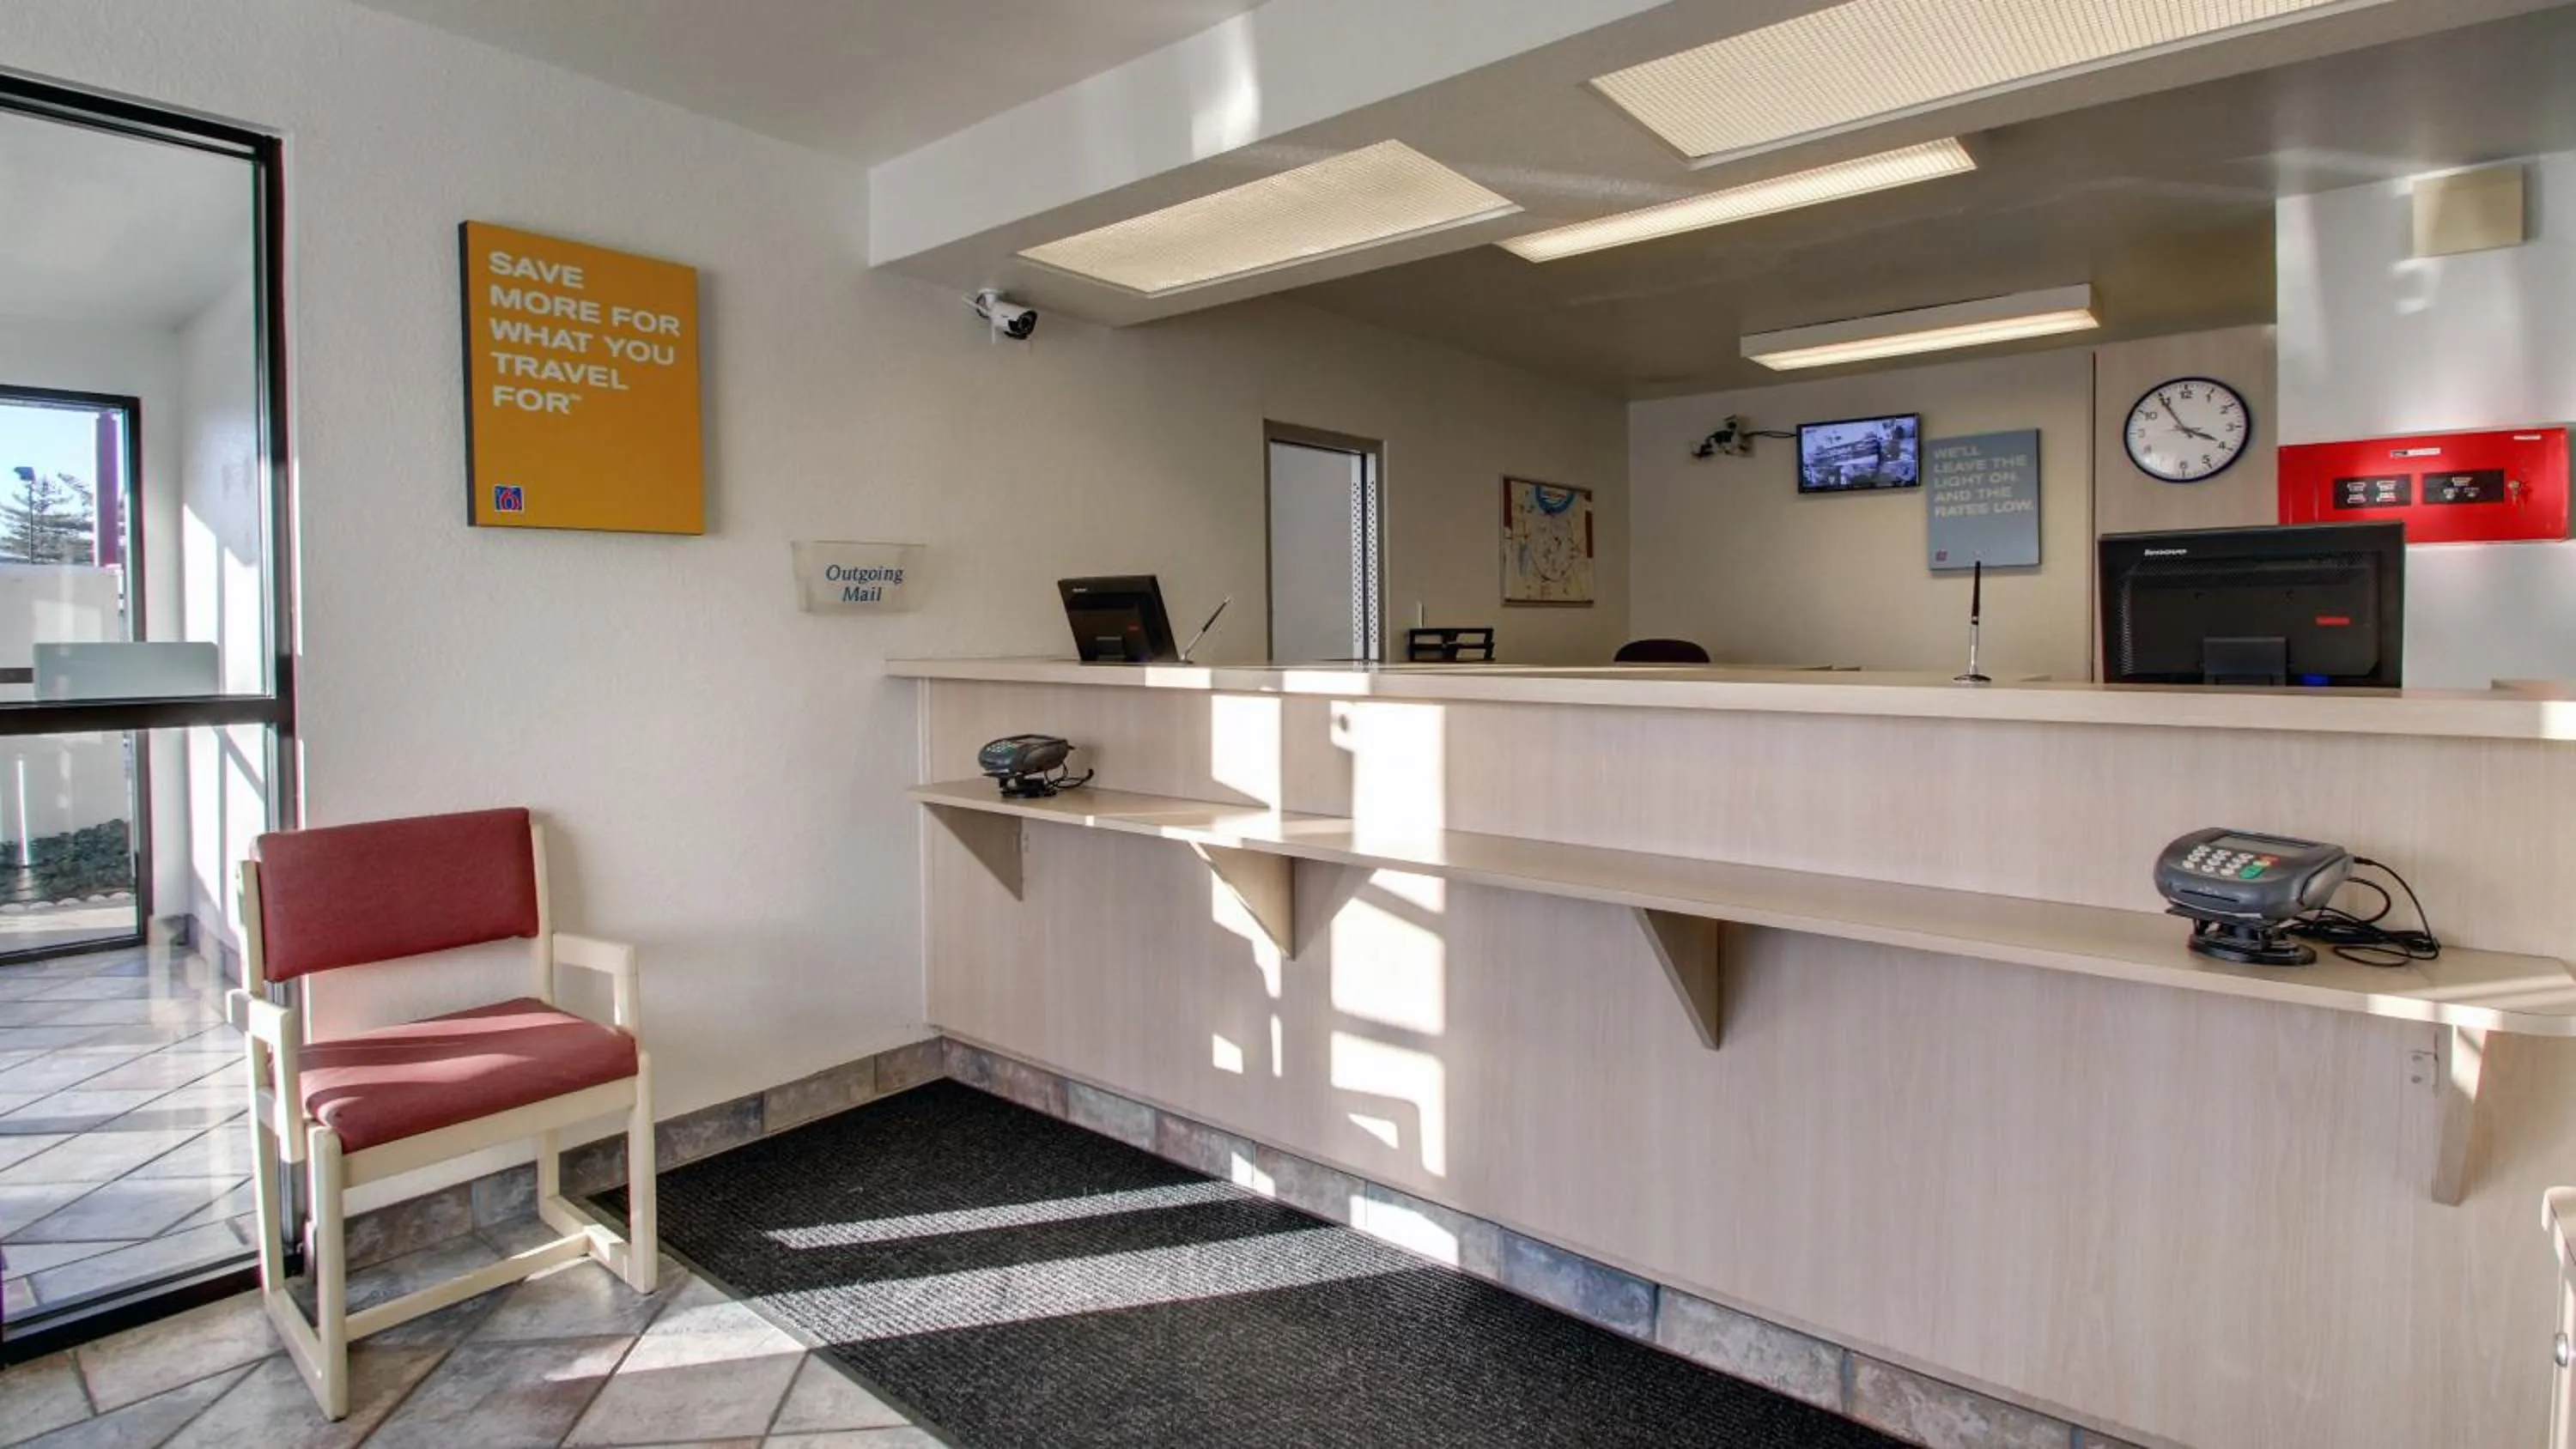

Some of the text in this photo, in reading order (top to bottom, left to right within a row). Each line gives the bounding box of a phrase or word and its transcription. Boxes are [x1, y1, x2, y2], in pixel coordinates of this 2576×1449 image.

[489, 250, 584, 289] SAVE
[490, 284, 681, 337] MORE FOR
[489, 317, 675, 366] WHAT YOU
[489, 351, 629, 390] TRAVEL
[1934, 454, 2027, 474] LEAVE THE
[1935, 473, 1984, 488] LIGHT
[1934, 485, 2013, 504] AND THE
[1934, 502, 1990, 518] RATES
[825, 564, 905, 585] Outgoing
[842, 586, 883, 603] Mail
